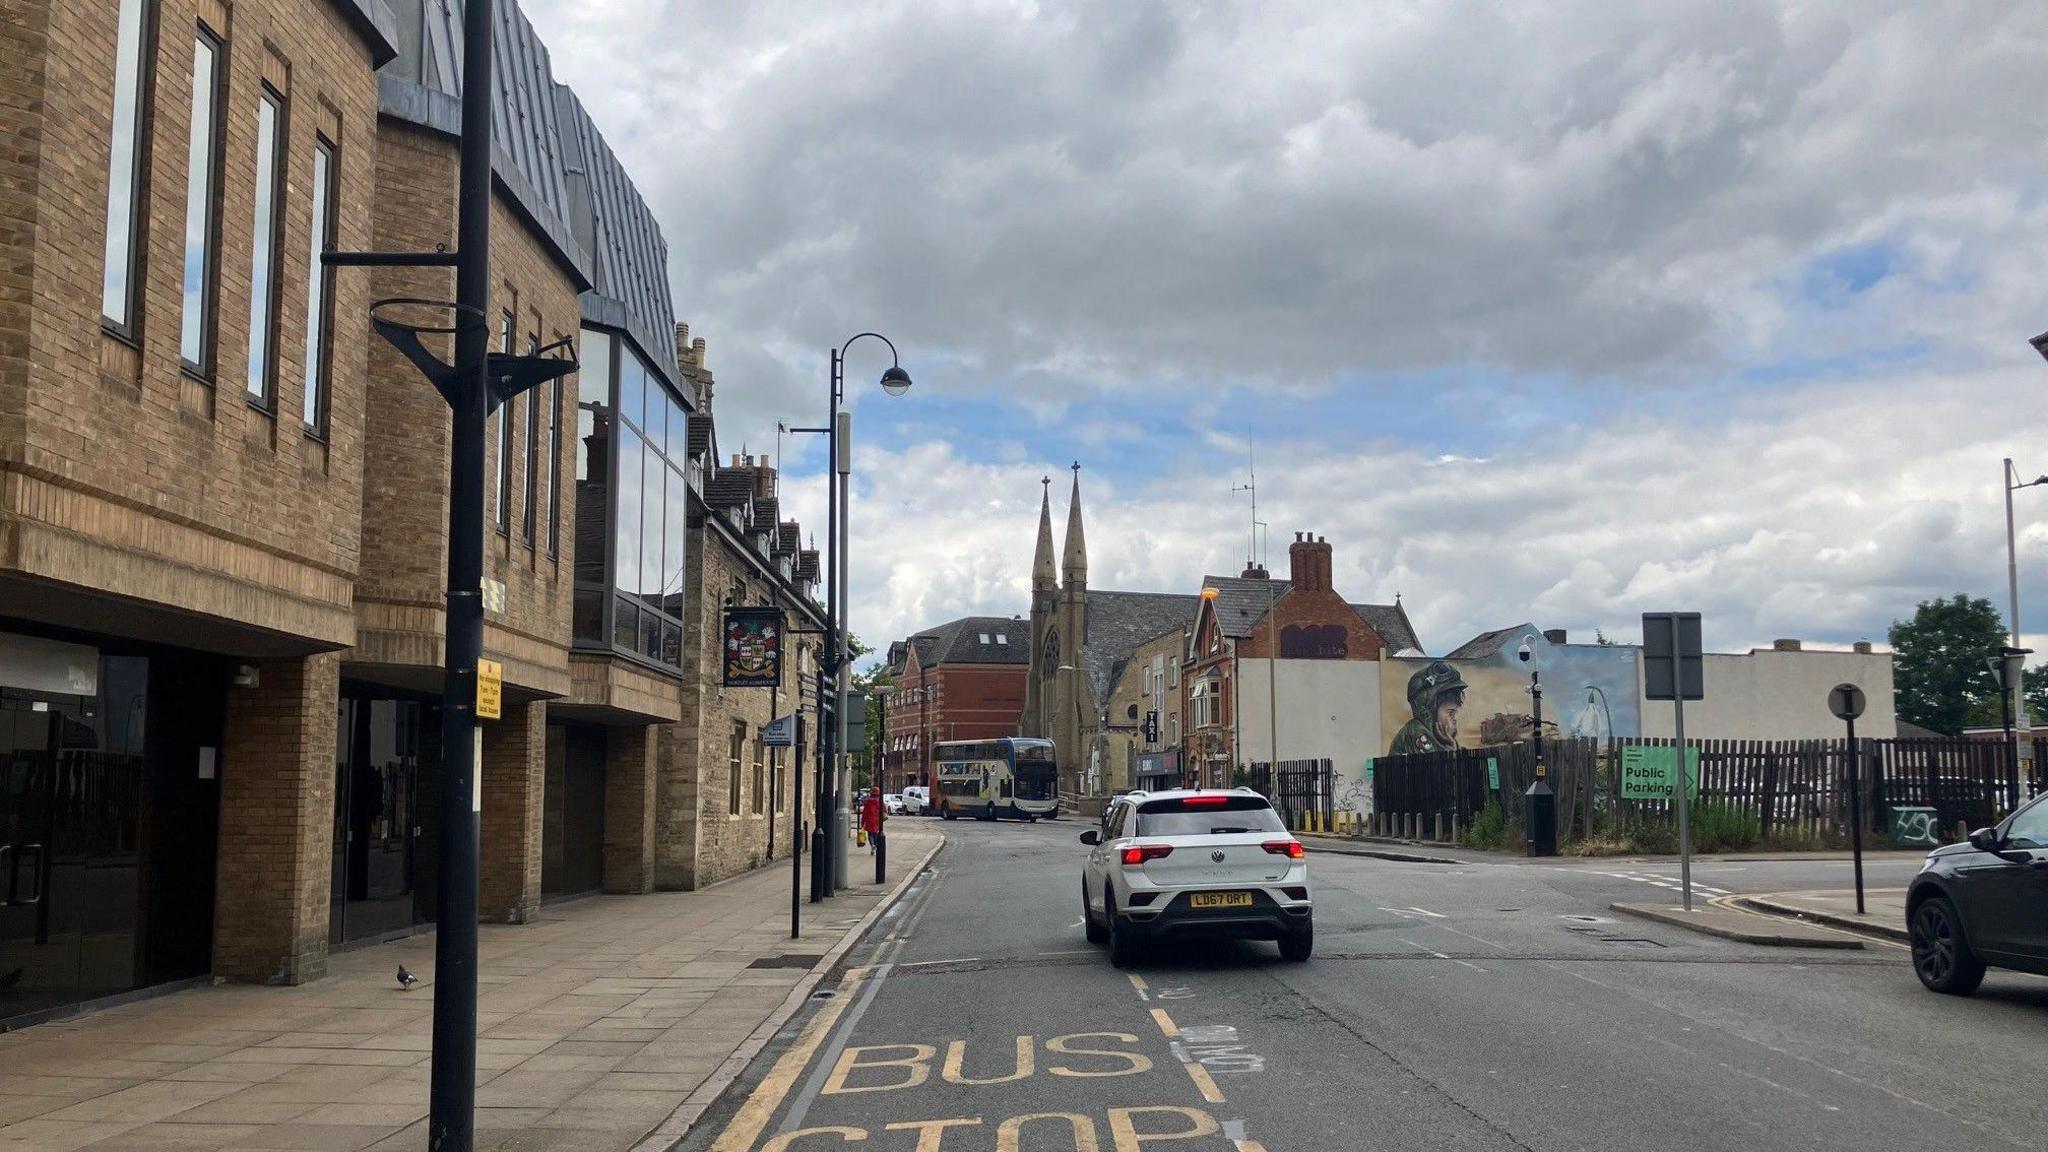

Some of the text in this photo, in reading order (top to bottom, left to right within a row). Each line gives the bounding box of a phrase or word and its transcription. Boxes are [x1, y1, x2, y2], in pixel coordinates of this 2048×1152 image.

[1148, 712, 1156, 742] TAXI
[1626, 767, 1665, 778] Public
[1626, 782, 1673, 796] Parking
[1195, 893, 1248, 905] LD67 ORT
[821, 1032, 1154, 1095] BUS
